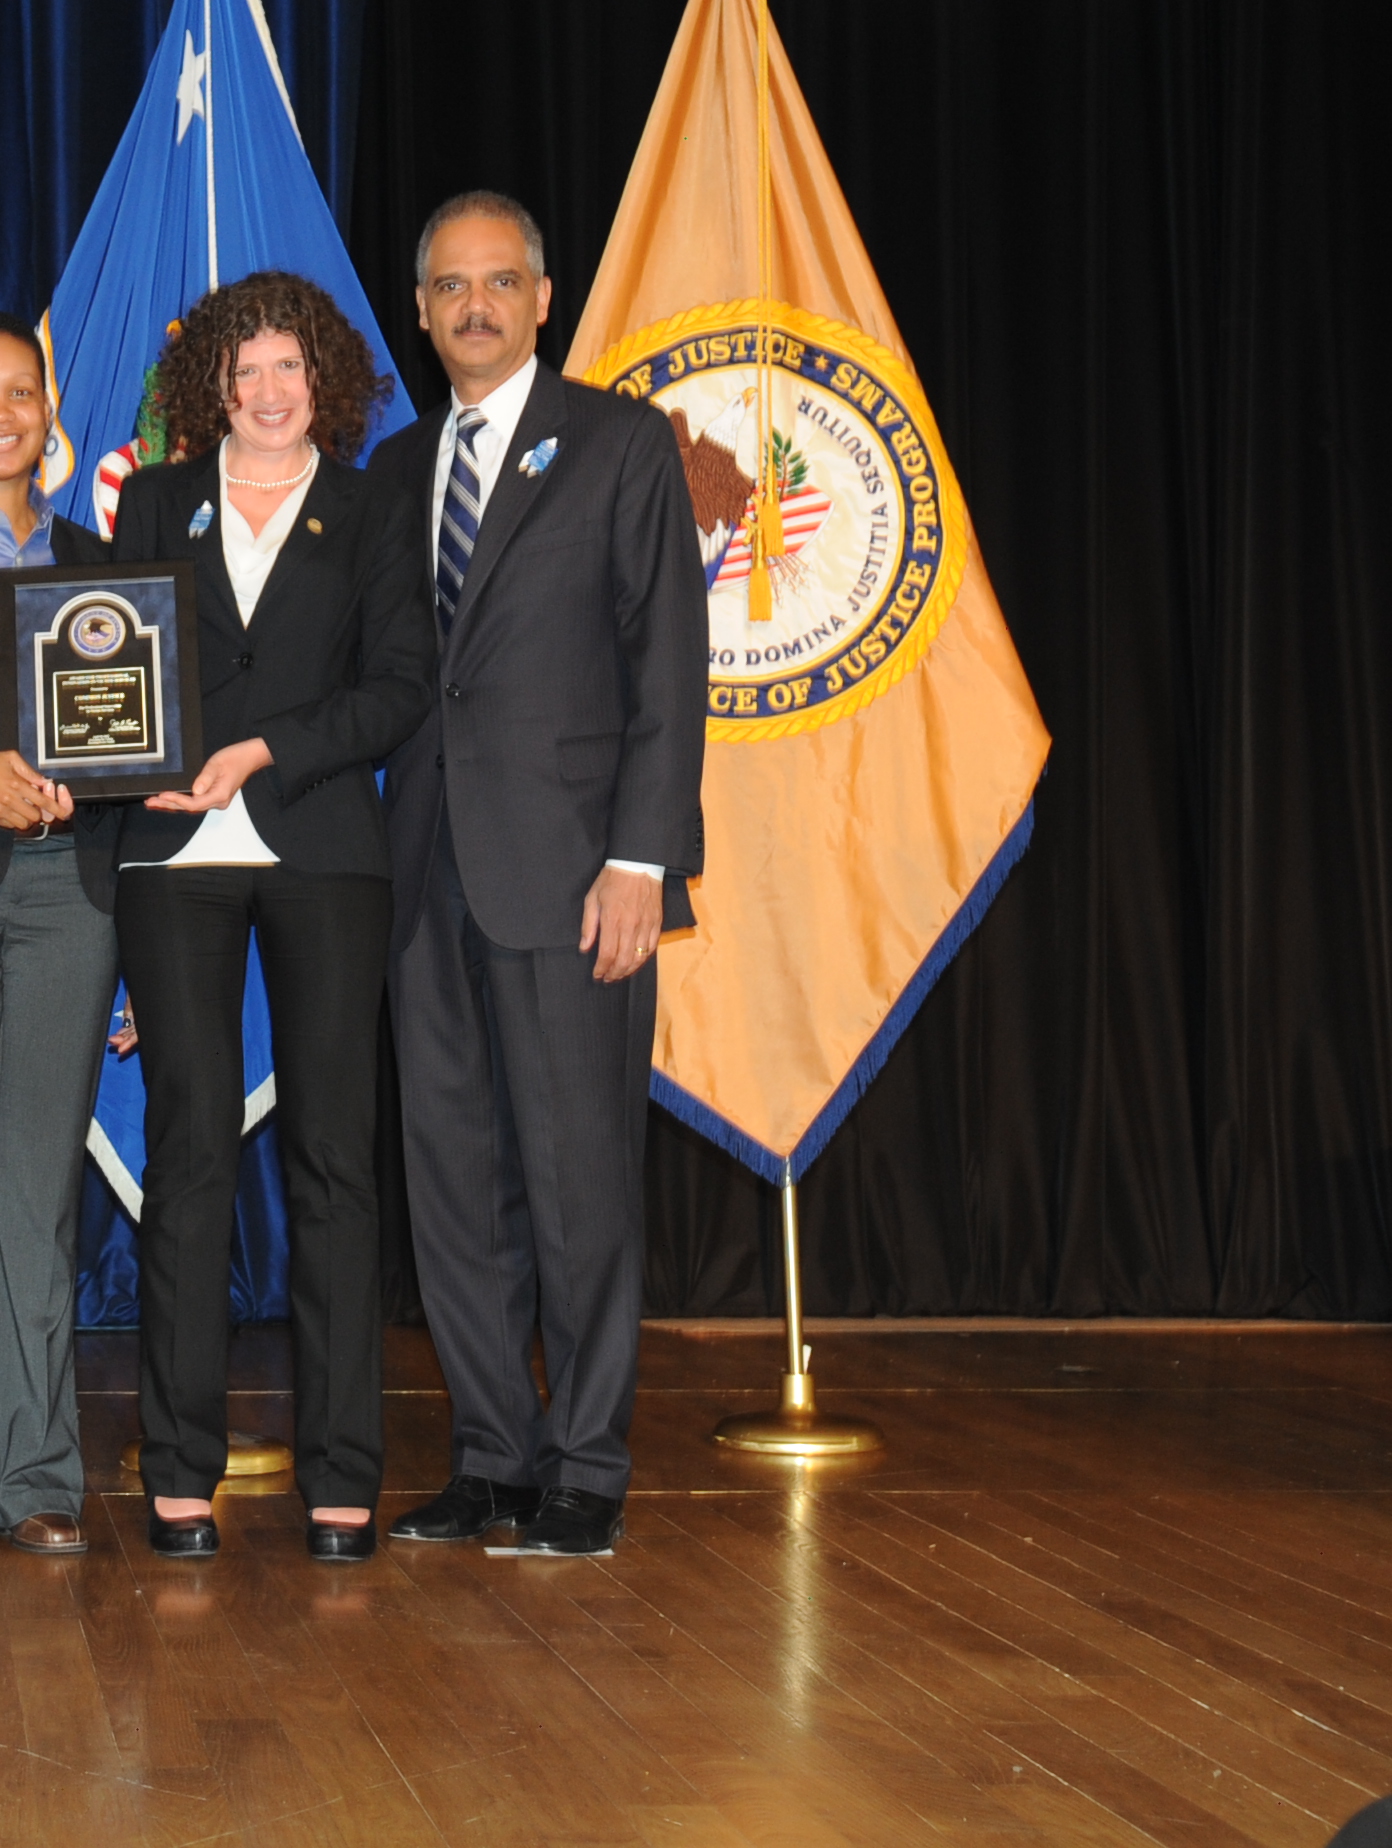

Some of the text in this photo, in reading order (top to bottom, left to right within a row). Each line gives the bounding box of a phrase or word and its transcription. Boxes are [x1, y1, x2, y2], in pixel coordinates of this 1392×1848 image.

[668, 331, 805, 378] JUSTICE
[797, 394, 884, 496] SEQUITUR
[709, 362, 938, 714] CE OF JUSTICE PROGRAMS
[847, 501, 889, 612] JUSTITIA
[745, 613, 848, 666] DOMINA
